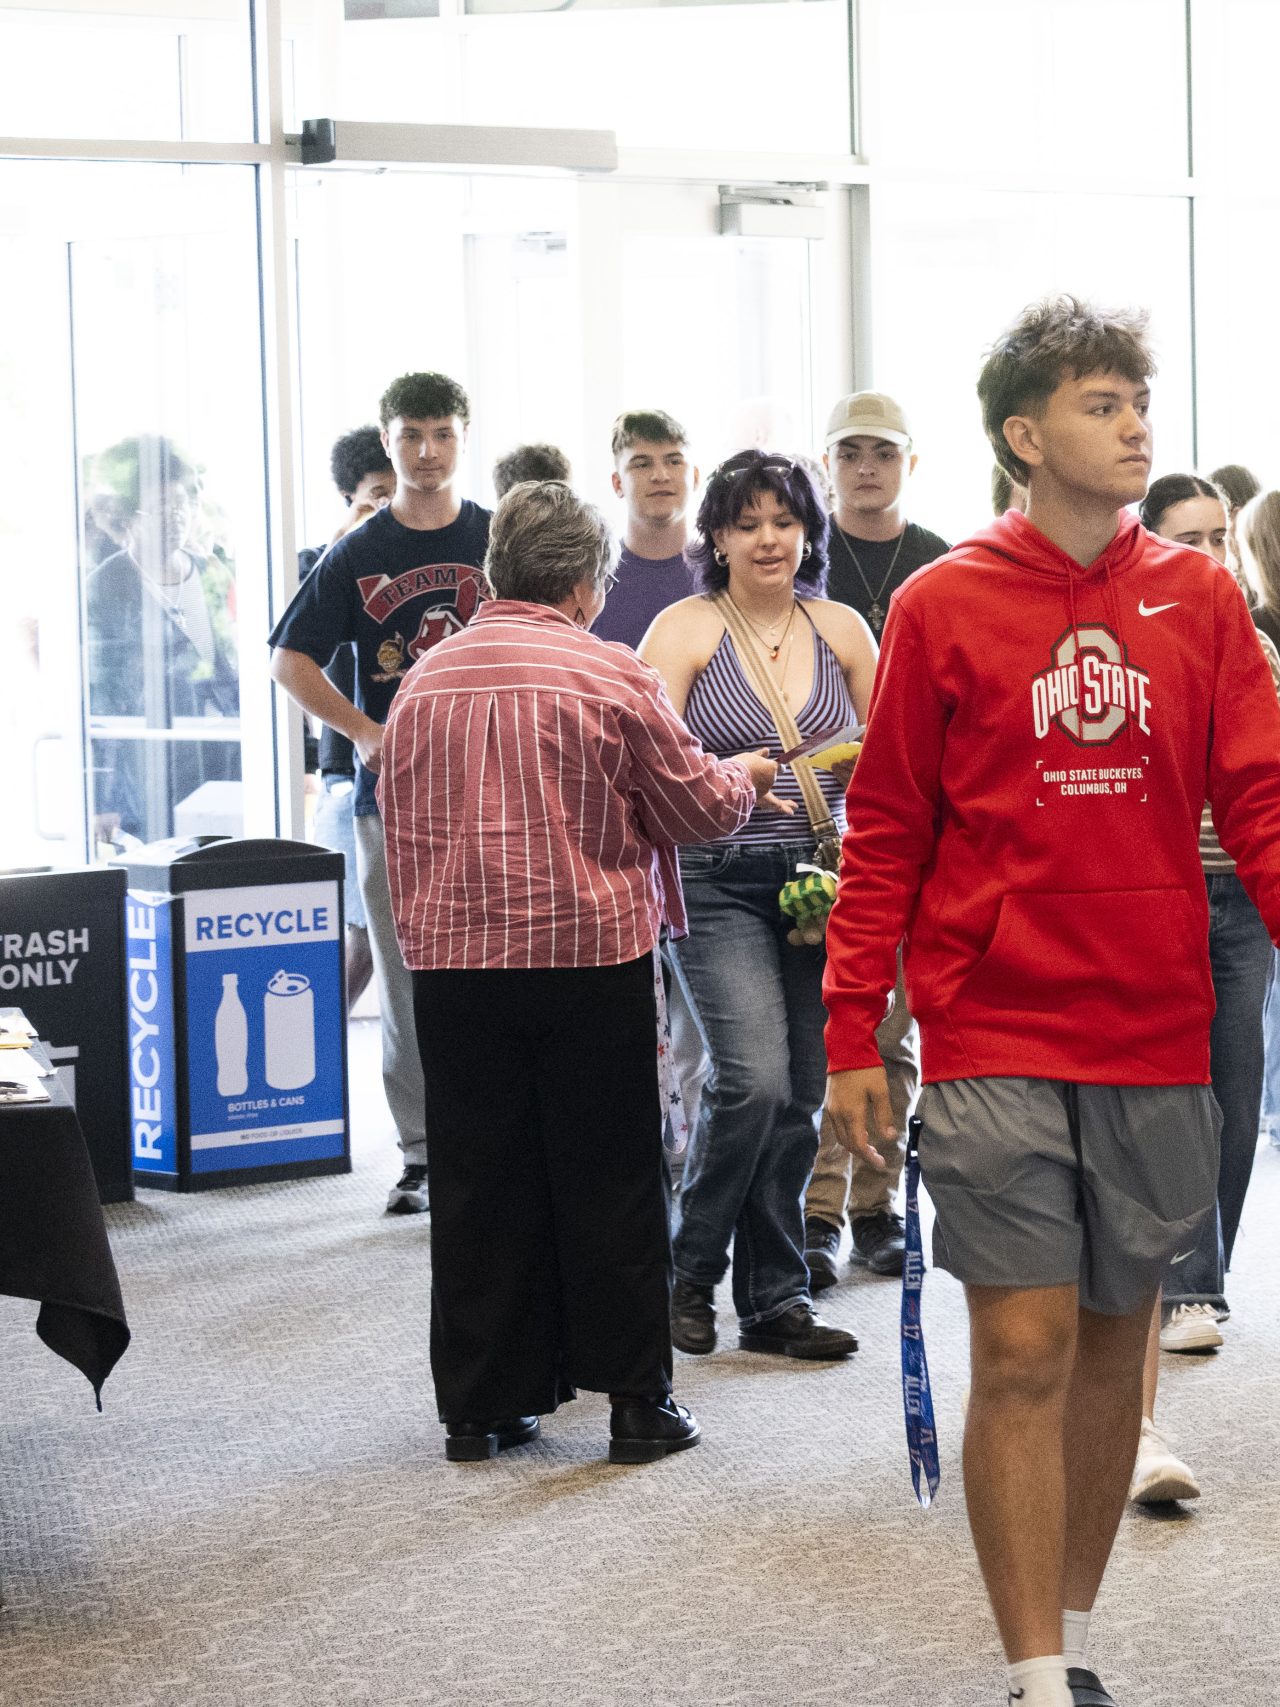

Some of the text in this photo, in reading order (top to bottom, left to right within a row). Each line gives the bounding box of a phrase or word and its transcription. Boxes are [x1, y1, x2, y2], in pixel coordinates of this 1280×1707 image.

[380, 568, 458, 606] TEAM
[1032, 655, 1151, 739] OHIO STATE
[1043, 770, 1067, 782] OHIO
[1069, 768, 1097, 781] STATE
[1061, 782, 1127, 795] COLUMBUS, OH
[196, 907, 328, 941] RECYCLE
[0, 958, 79, 990] ONLY
[128, 905, 162, 1160] RECYCLE
[227, 1095, 305, 1113] BOTTLES & CANS
[905, 1250, 921, 1290] ALLEN
[904, 1324, 920, 1341] 17
[905, 1374, 921, 1416] ALLEN
